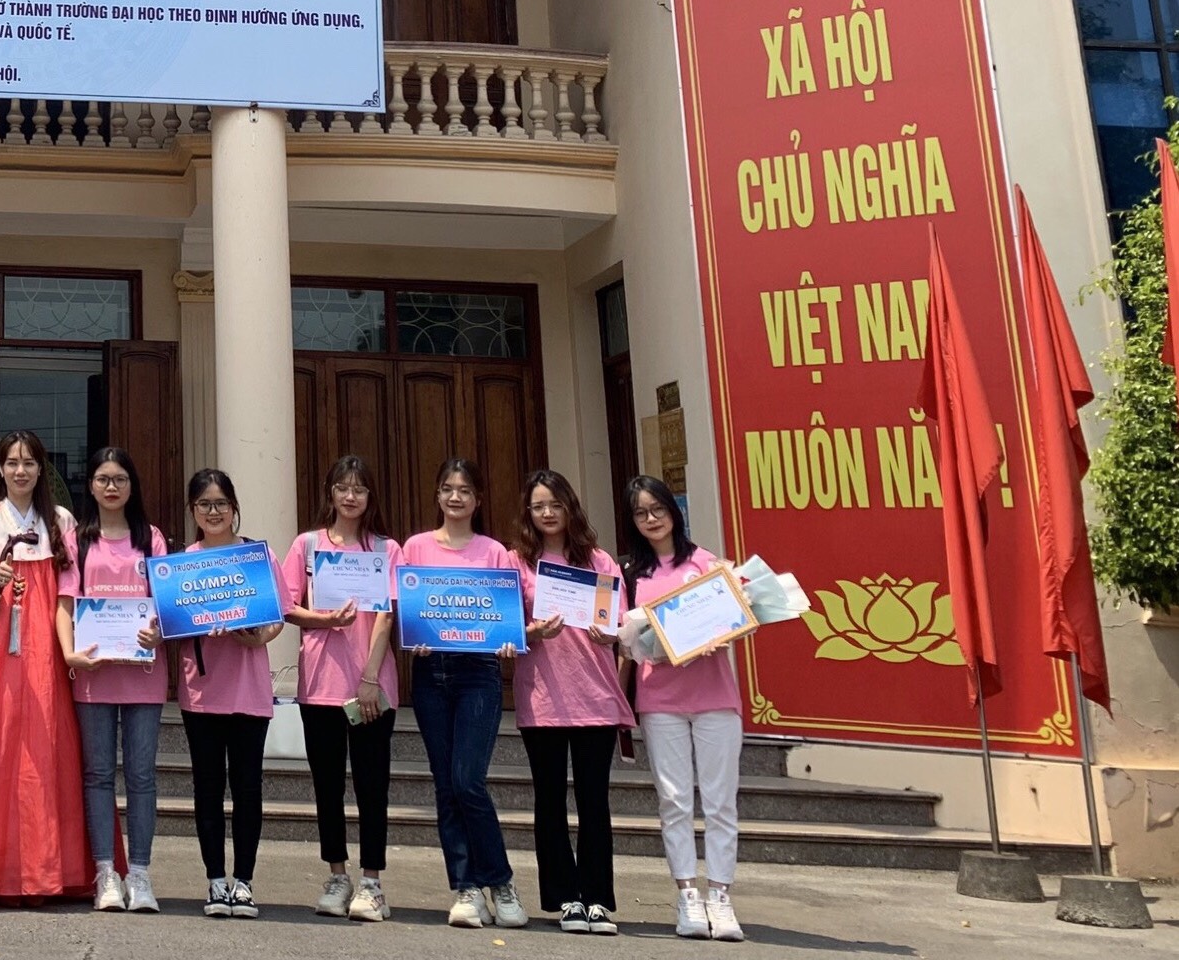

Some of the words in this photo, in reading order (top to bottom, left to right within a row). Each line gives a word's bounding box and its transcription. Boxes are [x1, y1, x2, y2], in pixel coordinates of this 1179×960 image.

[8, 0, 52, 17] THÀNH
[55, 1, 108, 19] TRƯỜNG
[111, 7, 133, 23] ĐẠI
[137, 8, 164, 24] HỌC
[168, 9, 201, 22] THEO
[204, 10, 237, 27] ĐỊNH
[241, 8, 287, 25] HƯỚNG
[291, 9, 319, 26] ỨNG
[323, 14, 364, 31] DỤNG,
[760, 7, 818, 99] XÃ
[737, 129, 815, 233] CHỦ
[823, 123, 956, 224] NGHĨA
[759, 271, 844, 384] VIỆT
[744, 410, 870, 510] MUÔN
[875, 406, 944, 509] NĂ
[175, 595, 208, 606] NGOẠI
[233, 587, 256, 598] 2022
[181, 573, 245, 593] OLYMPIC
[419, 610, 453, 622] NGOẠI
[479, 612, 502, 621] 2022
[428, 594, 492, 608] OLYMPIC
